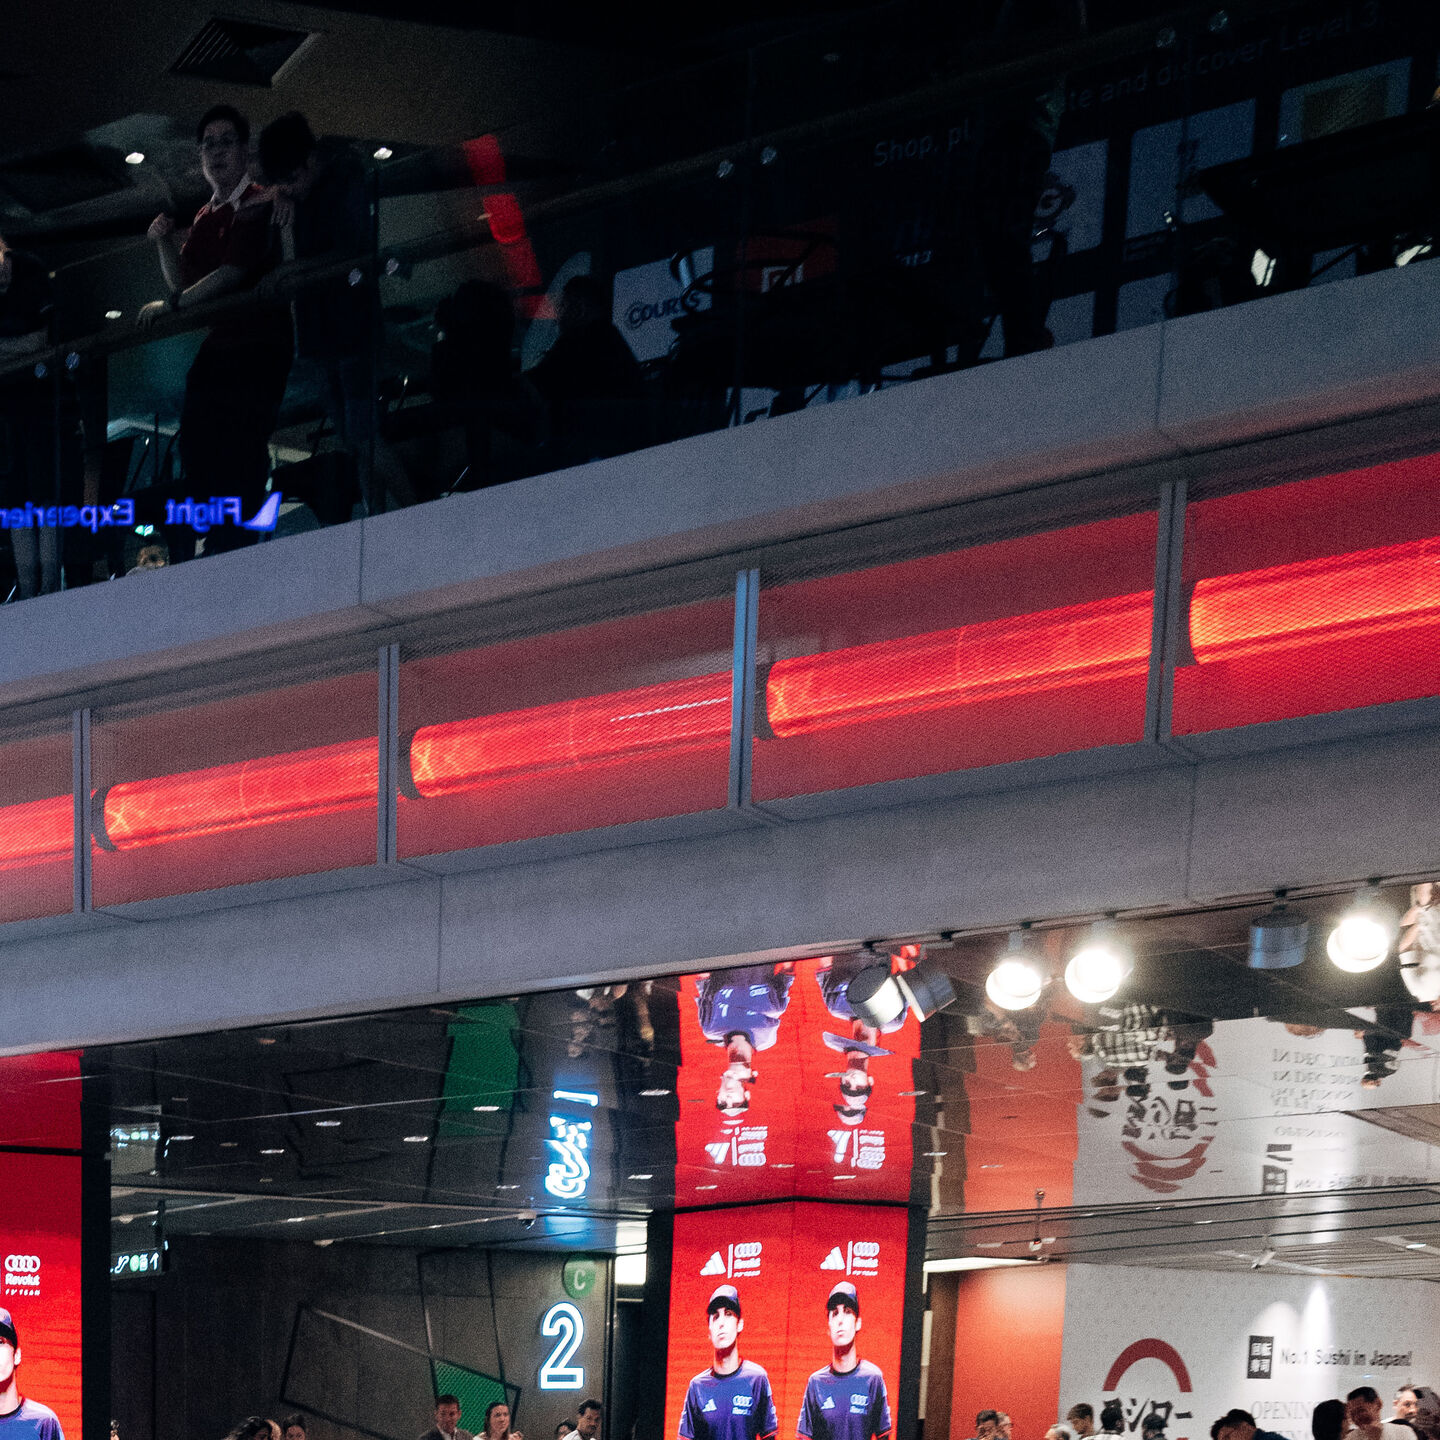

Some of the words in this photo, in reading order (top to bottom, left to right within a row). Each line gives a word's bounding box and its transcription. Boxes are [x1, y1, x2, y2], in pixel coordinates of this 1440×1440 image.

[573, 1269, 586, 1291] C
[540, 1301, 585, 1390] 2
[1315, 1349, 1351, 1366] Sushi
[1353, 1350, 1366, 1366] in
[1370, 1350, 1413, 1369] Japan!
